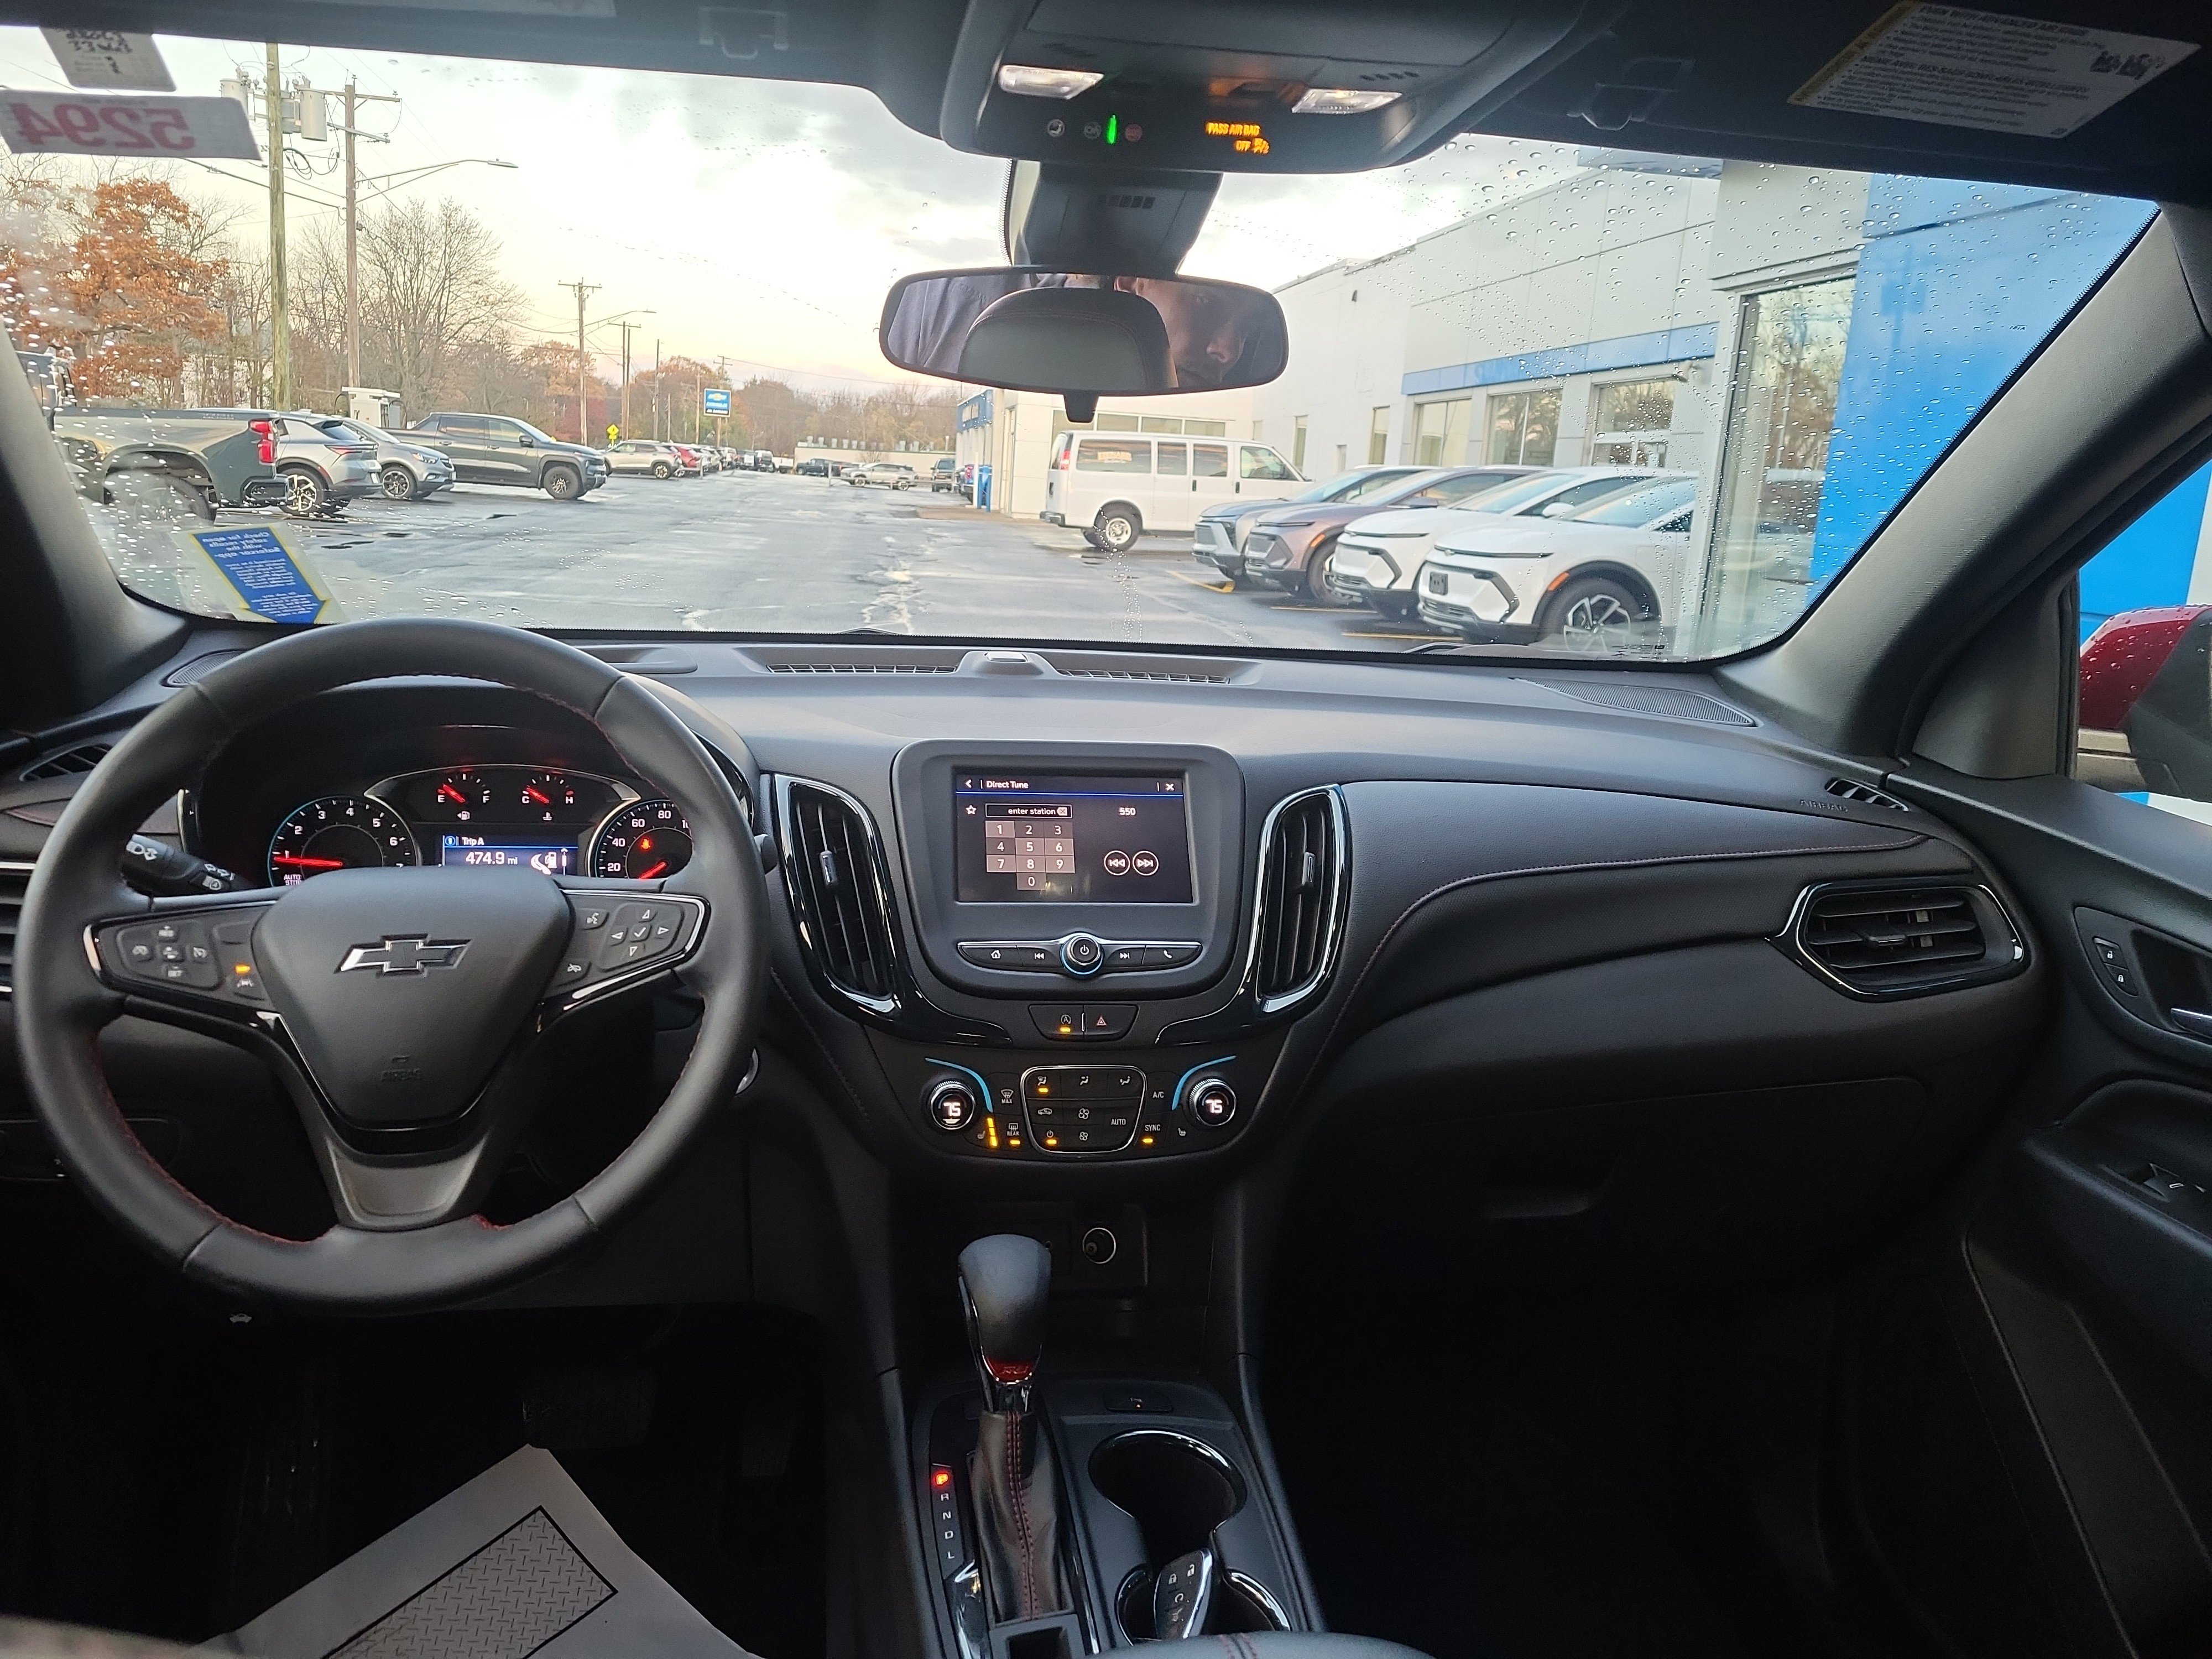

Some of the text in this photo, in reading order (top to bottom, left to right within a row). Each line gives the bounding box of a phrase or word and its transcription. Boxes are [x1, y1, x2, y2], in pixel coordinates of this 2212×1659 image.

[1207, 122, 1260, 136] PASS AIR BAG
[1235, 140, 1251, 151] OFF
[987, 780, 1029, 789] Direct Tune
[318, 811, 326, 820] 3
[346, 808, 354, 816] 4
[658, 810, 671, 819] 80
[1030, 807, 1056, 816] station
[1119, 807, 1136, 816] 550
[373, 818, 380, 827] 5
[632, 819, 645, 827] 60
[294, 826, 302, 834] 2
[997, 825, 1061, 835] 1 2 3
[389, 837, 398, 846] 6
[462, 837, 485, 846] Trip A
[612, 838, 625, 847] 40
[997, 842, 1063, 852] 4 5 6
[465, 852, 505, 865] 474.9
[607, 863, 621, 872] 20
[997, 859, 1063, 869] 7 8 9
[1027, 877, 1035, 886] 0
[943, 1102, 961, 1116] 75
[1206, 1100, 1223, 1113] 75
[936, 1473, 949, 1485] P
[942, 1511, 951, 1519] N
[945, 1530, 954, 1539] D
[947, 1551, 955, 1559] L
